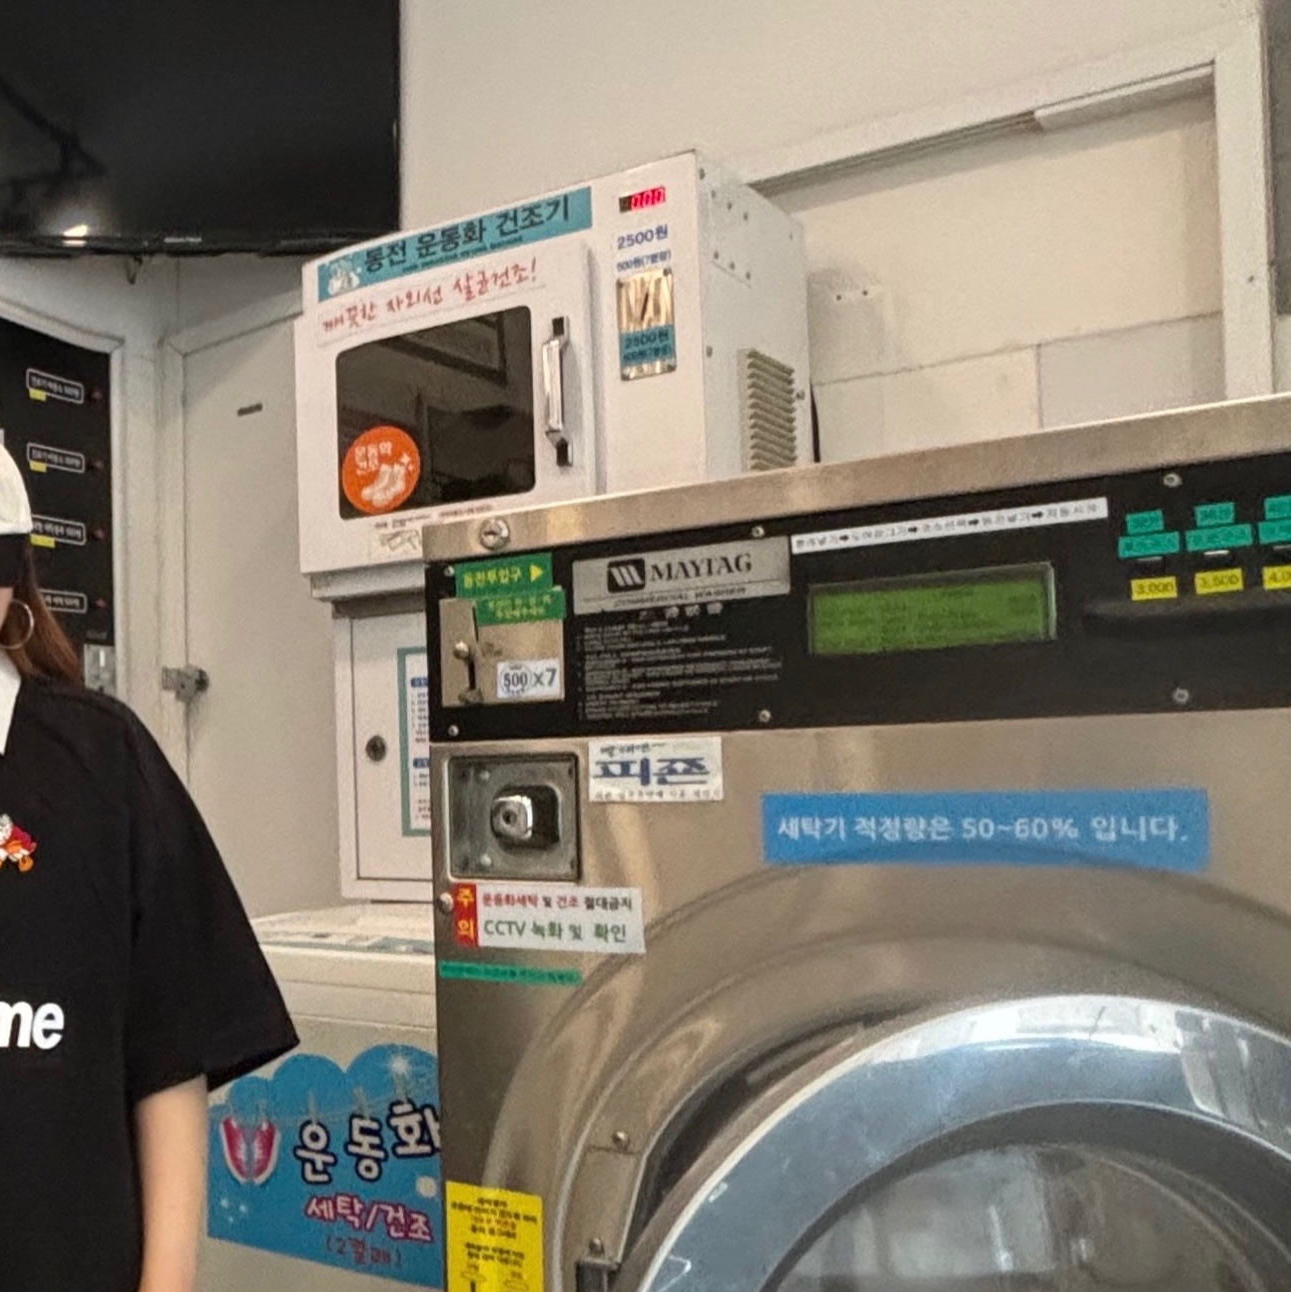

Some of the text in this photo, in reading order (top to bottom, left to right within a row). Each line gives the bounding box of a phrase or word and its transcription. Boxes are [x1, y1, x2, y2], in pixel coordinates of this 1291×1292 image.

[364, 238, 408, 273] 동전
[416, 218, 486, 258] 운동화
[496, 194, 569, 239] 건조기
[617, 224, 669, 250] 2500원
[650, 553, 753, 582] MAYTAG
[776, 815, 1189, 843] 세탁기 적정량은 50~60% 입니다.
[483, 919, 527, 937] CCTV
[531, 921, 564, 941] 녹화
[593, 922, 627, 943] 확인
[294, 1099, 441, 1184] 운동화
[306, 1193, 433, 1243] 세탁/건조
